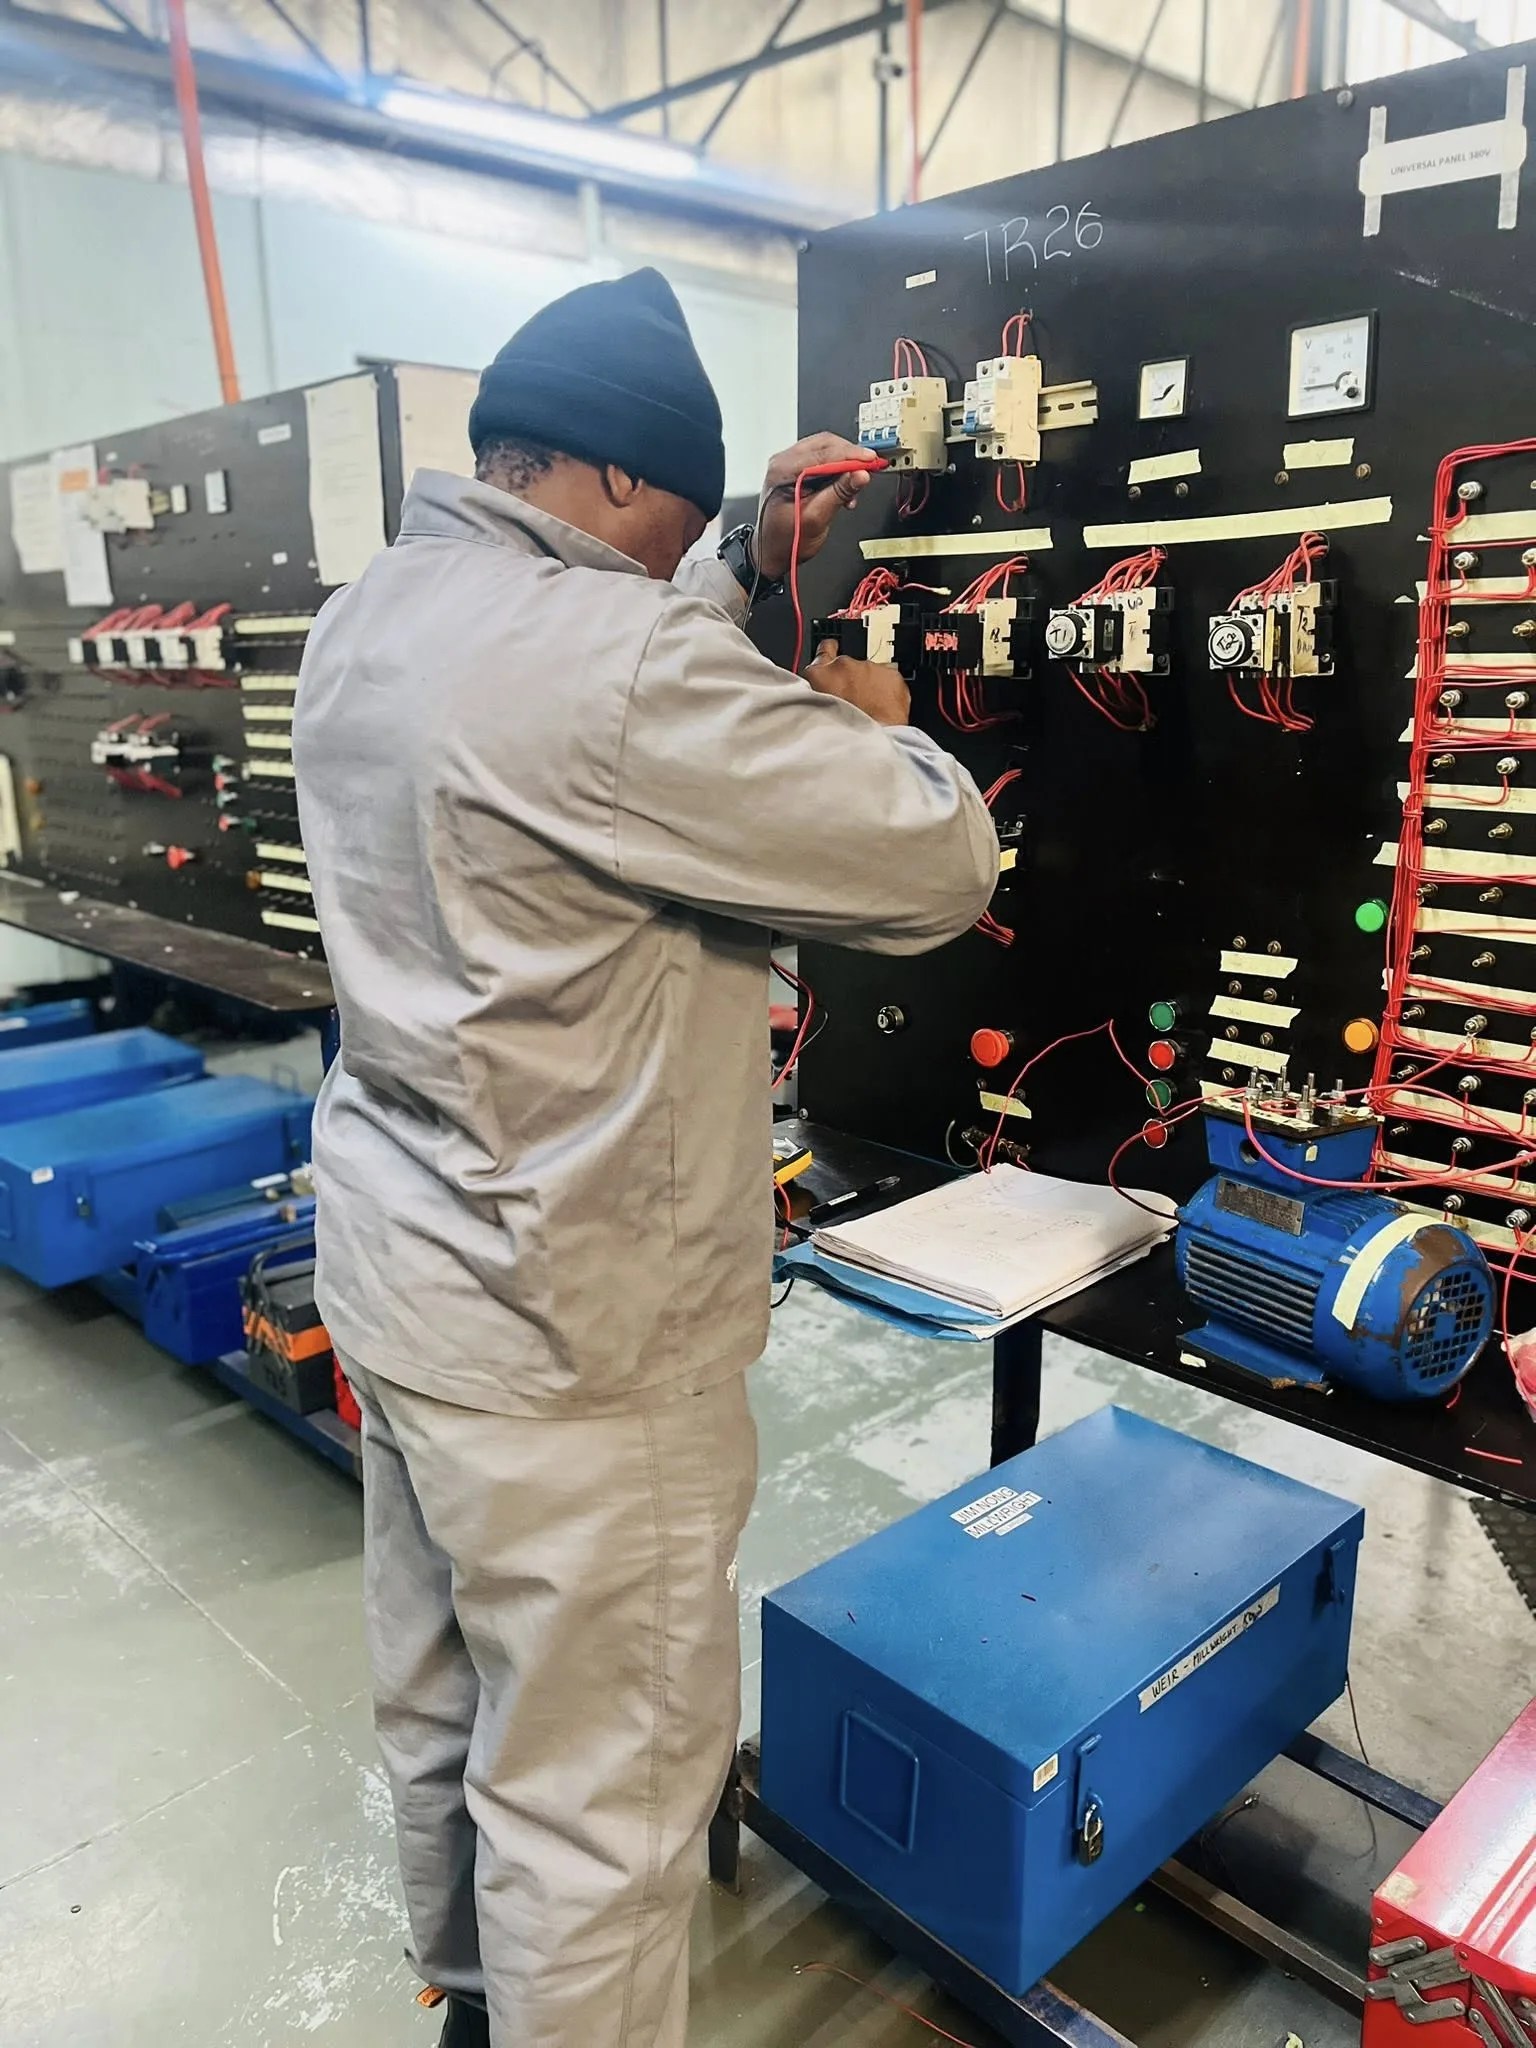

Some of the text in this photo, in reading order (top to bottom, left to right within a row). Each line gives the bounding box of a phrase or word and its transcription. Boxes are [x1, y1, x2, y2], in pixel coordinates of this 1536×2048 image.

[1390, 149, 1491, 175] UNIVERSAL PANEL 380V
[963, 201, 1104, 285] TR26
[1127, 597, 1143, 610] UP
[957, 1487, 1014, 1522] JIM NONG
[967, 1492, 1039, 1537] MILLWRIGHT
[1151, 1668, 1179, 1698] WEIR
[1192, 1624, 1238, 1667] MILLWRIGHT
